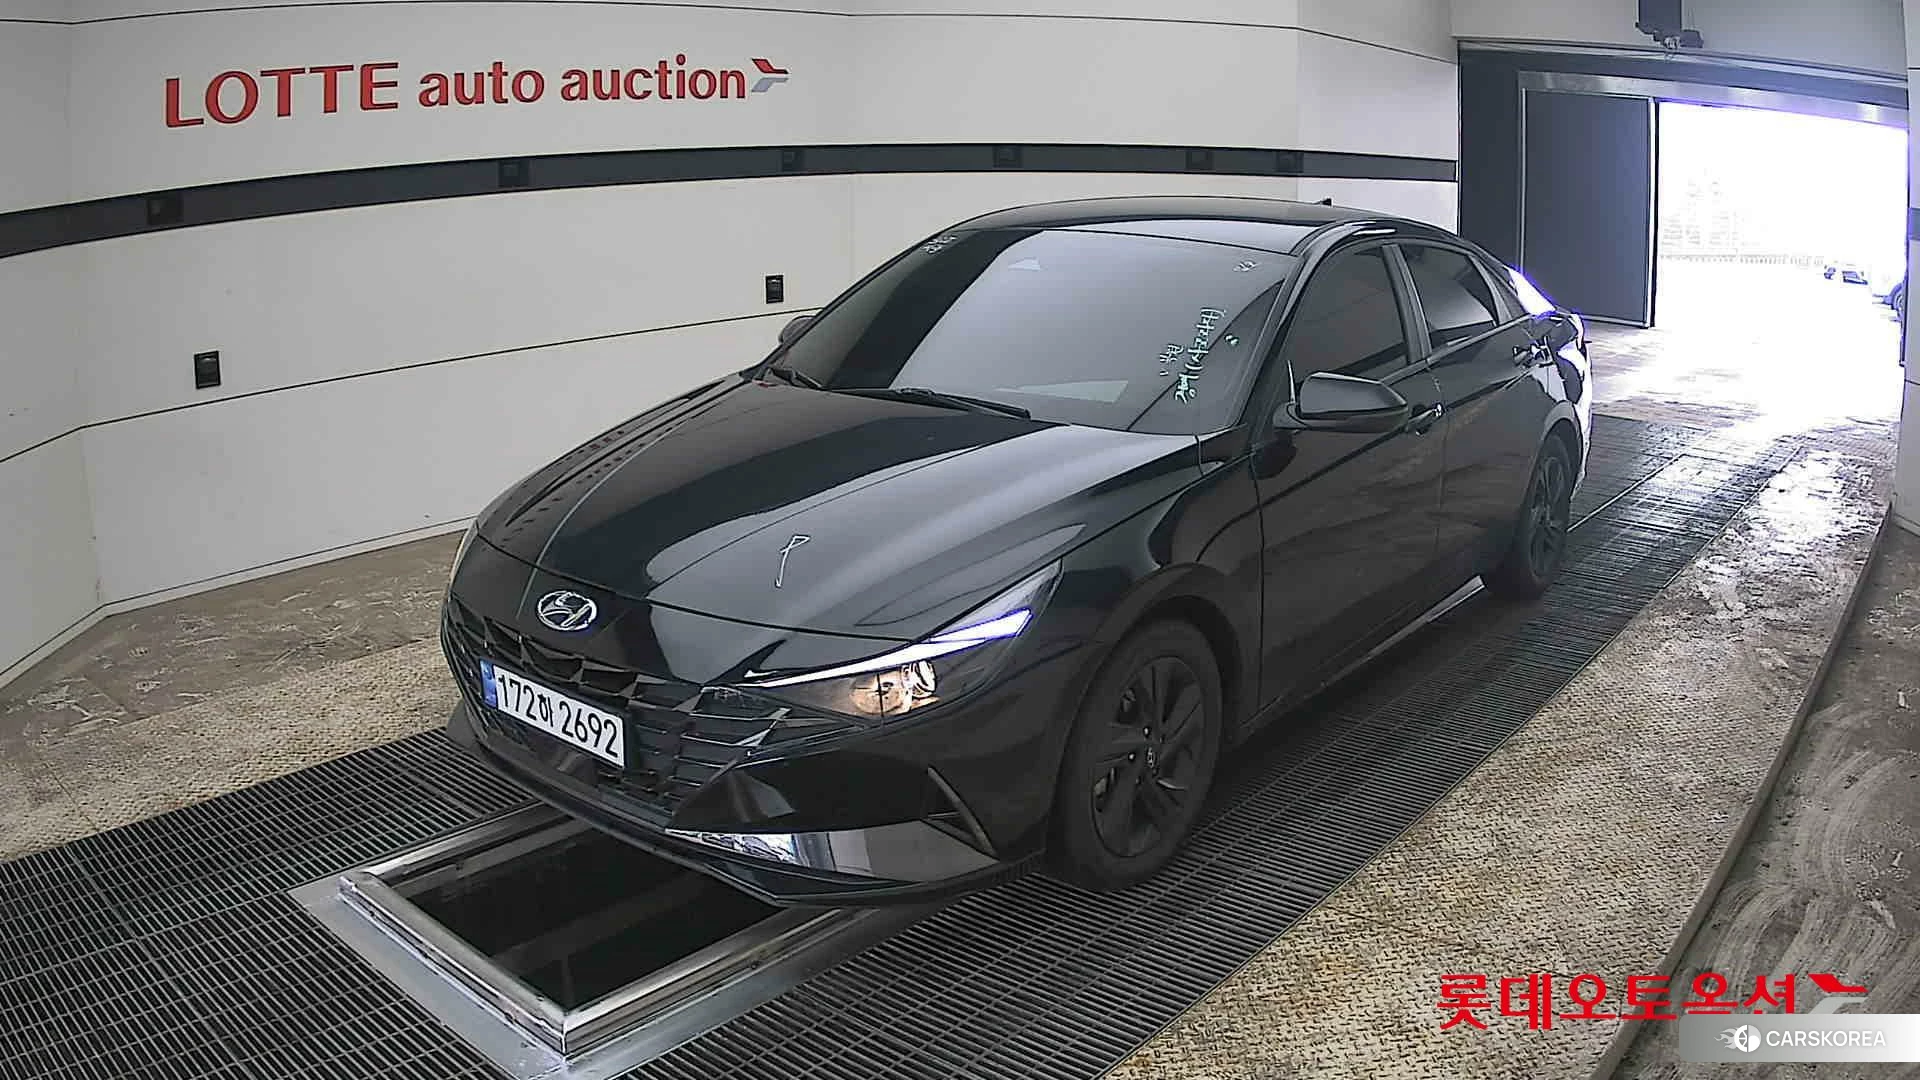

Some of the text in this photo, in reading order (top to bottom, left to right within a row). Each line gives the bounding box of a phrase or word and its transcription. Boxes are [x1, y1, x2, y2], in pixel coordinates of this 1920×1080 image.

[165, 53, 747, 128] LOTTE auto auction
[559, 700, 618, 758] 2692
